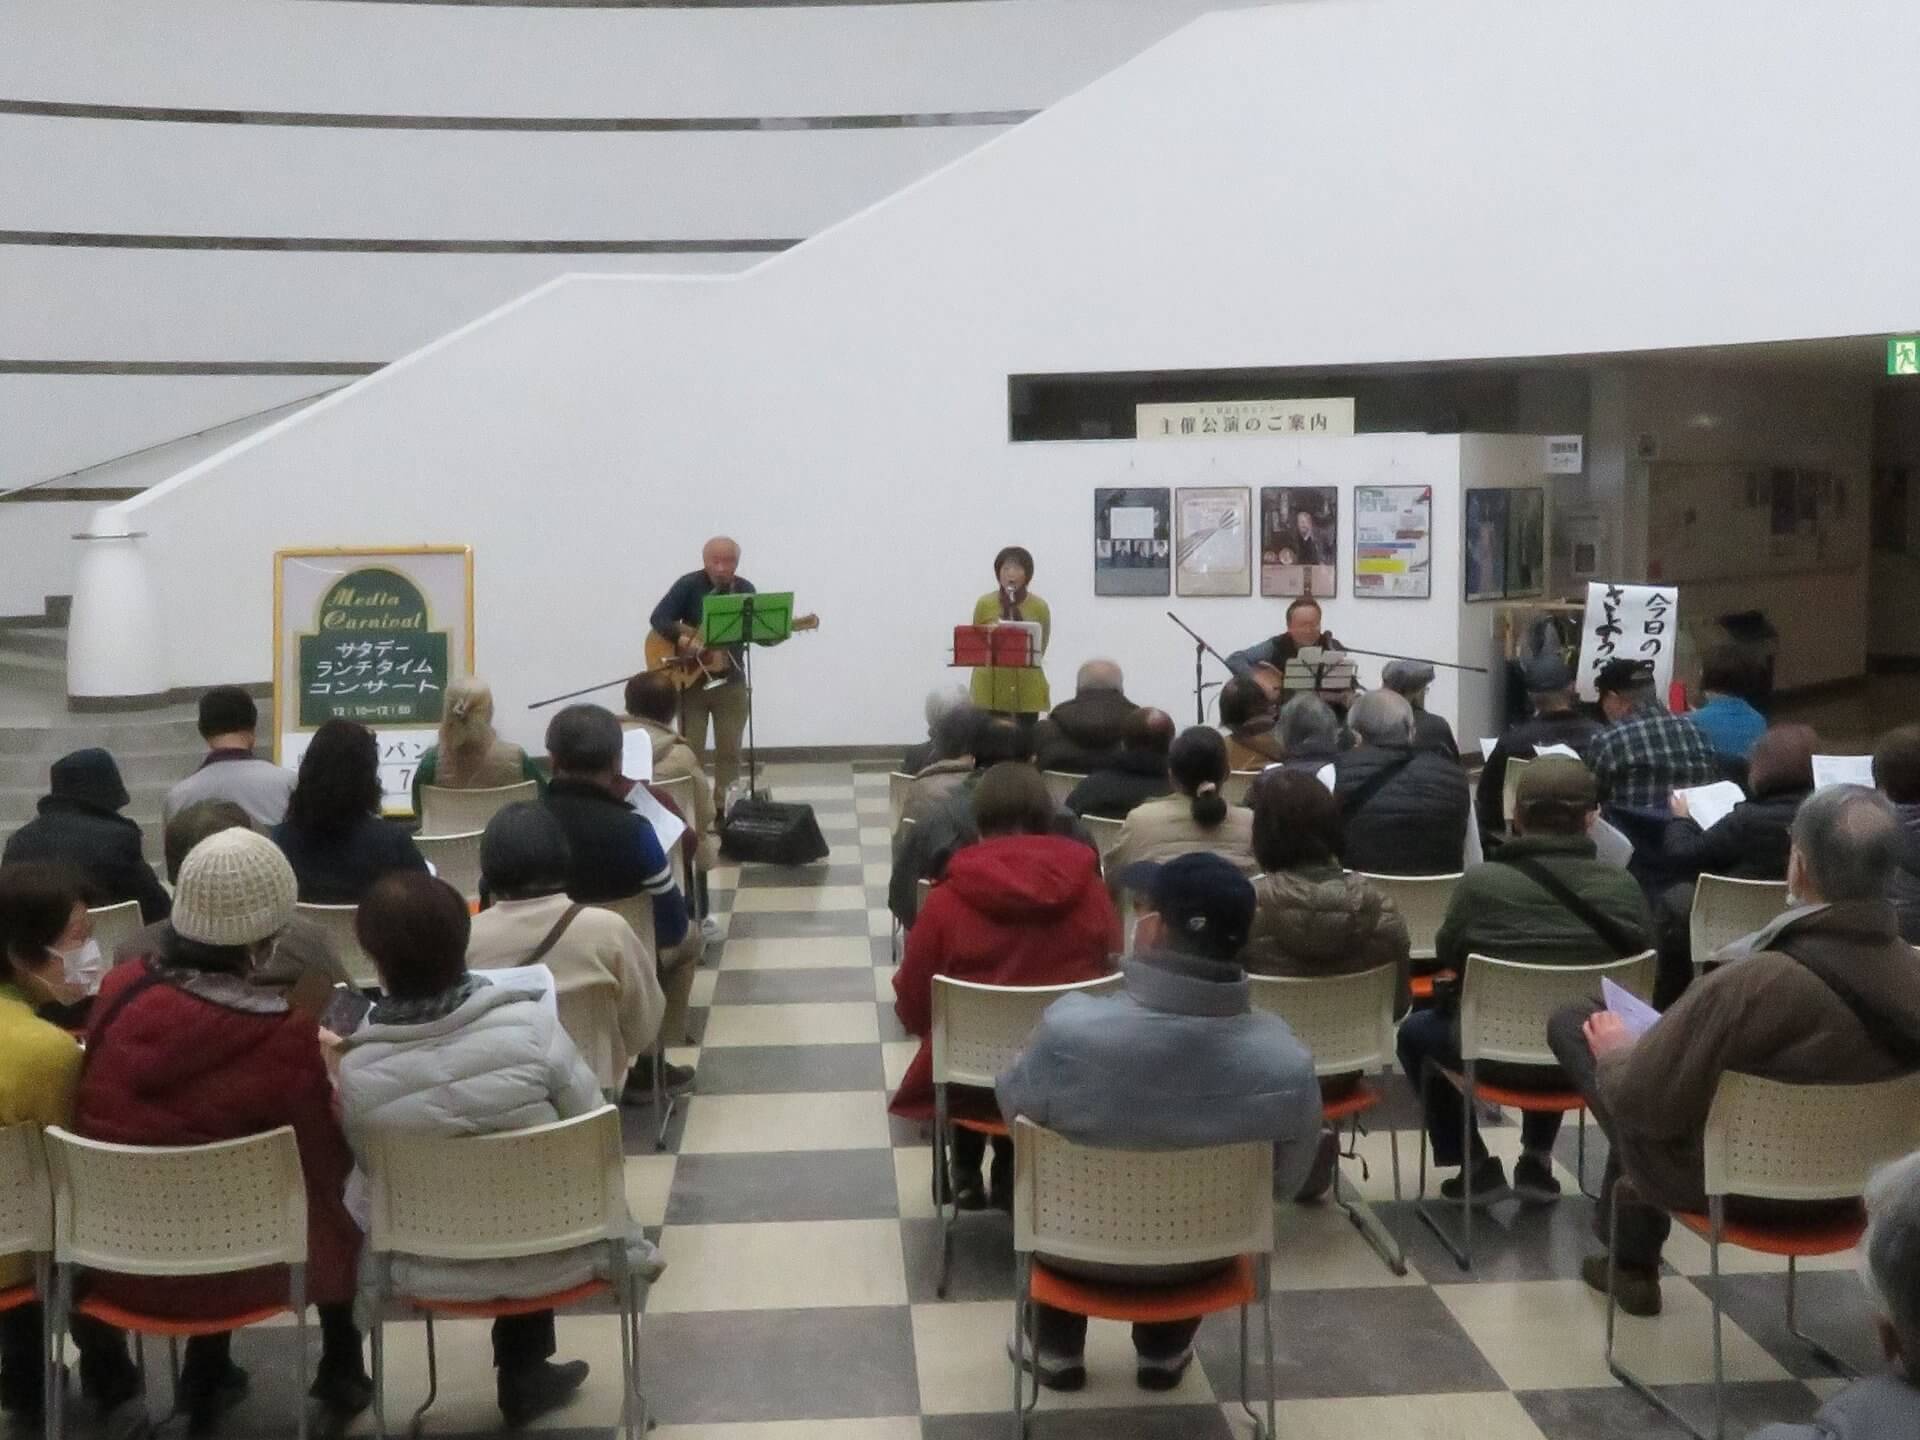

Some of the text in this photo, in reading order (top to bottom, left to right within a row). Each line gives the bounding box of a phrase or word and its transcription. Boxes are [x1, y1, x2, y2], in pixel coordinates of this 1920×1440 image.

[326, 588, 400, 606] Media
[323, 609, 422, 629] Carnival
[336, 639, 409, 658] サタデー
[316, 658, 433, 678] ランチタイム
[309, 678, 440, 695] コンサート
